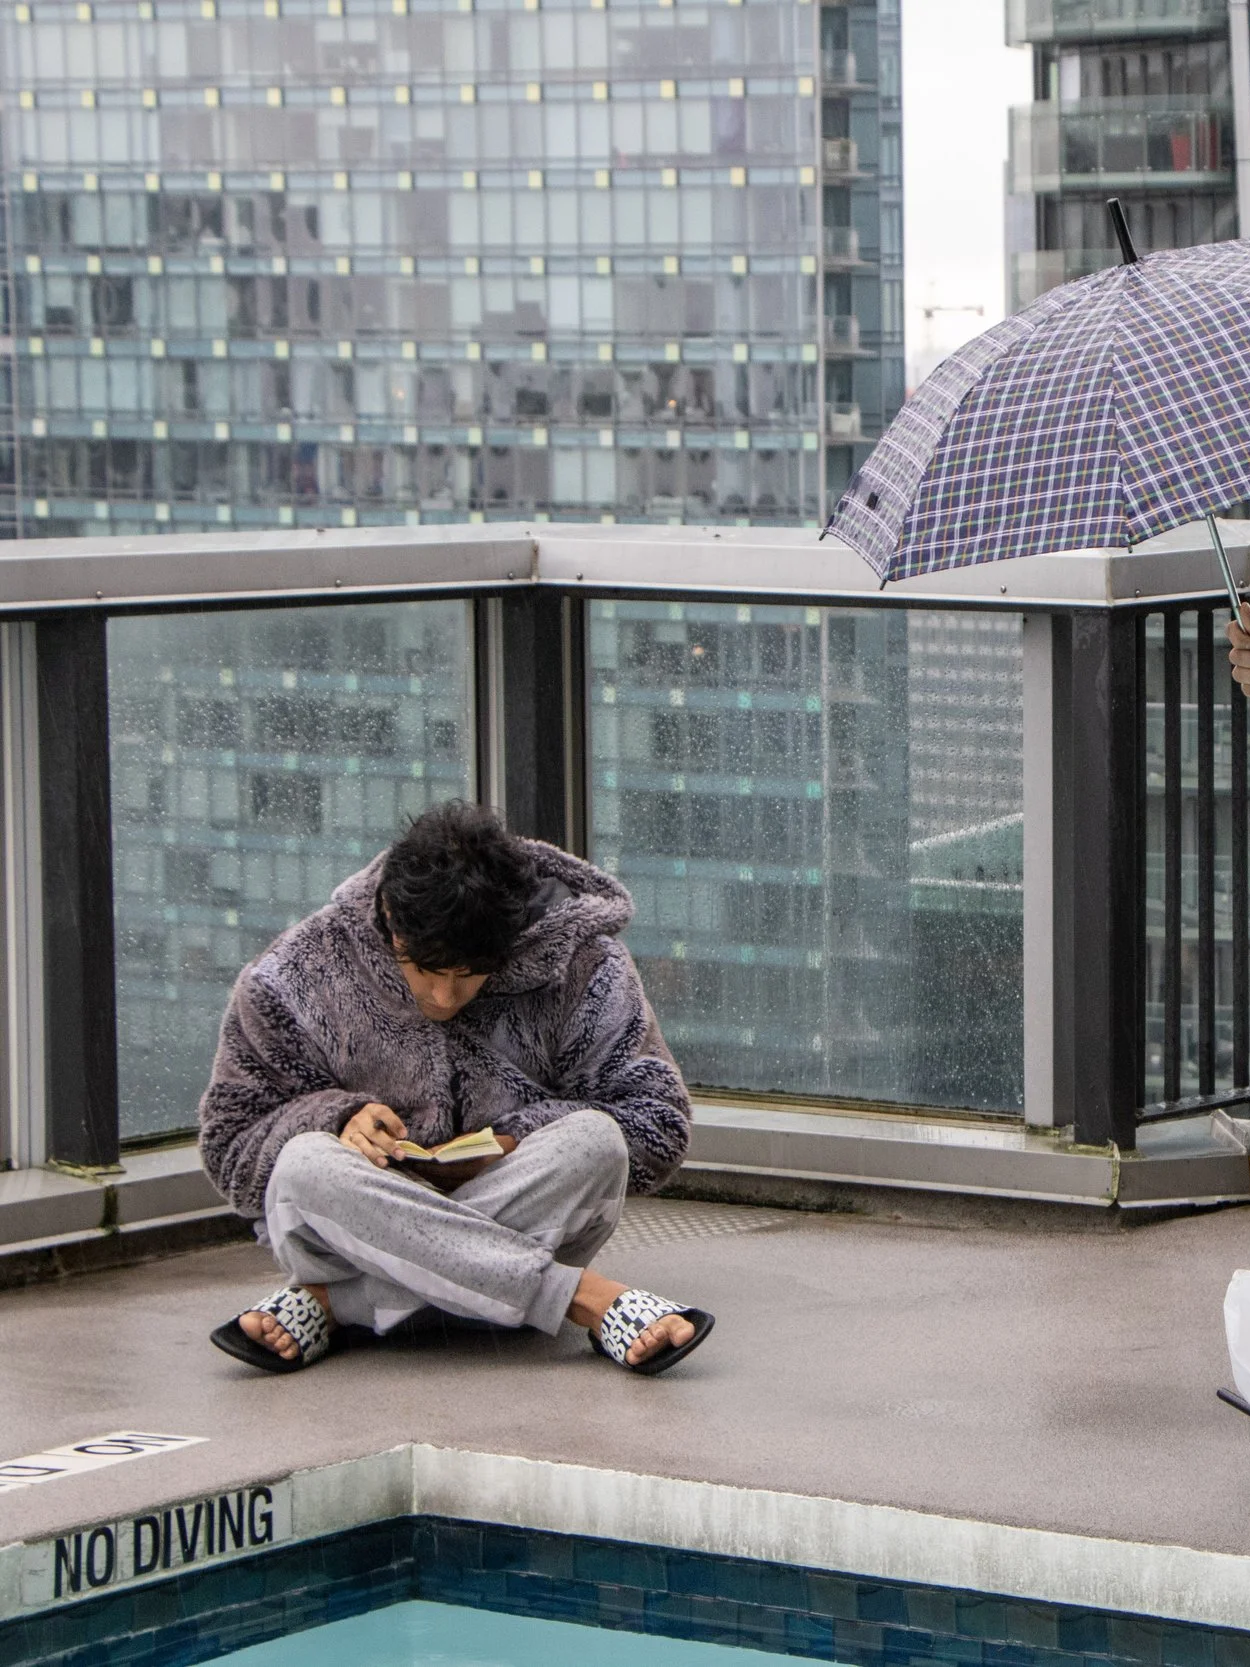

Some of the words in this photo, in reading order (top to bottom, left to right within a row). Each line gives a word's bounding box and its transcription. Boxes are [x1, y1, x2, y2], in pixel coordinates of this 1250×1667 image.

[278, 1294, 308, 1320] DO
[622, 1295, 655, 1321] DO
[73, 1434, 192, 1456] NO
[53, 1526, 115, 1598] NO
[133, 1486, 274, 1576] DIVING
